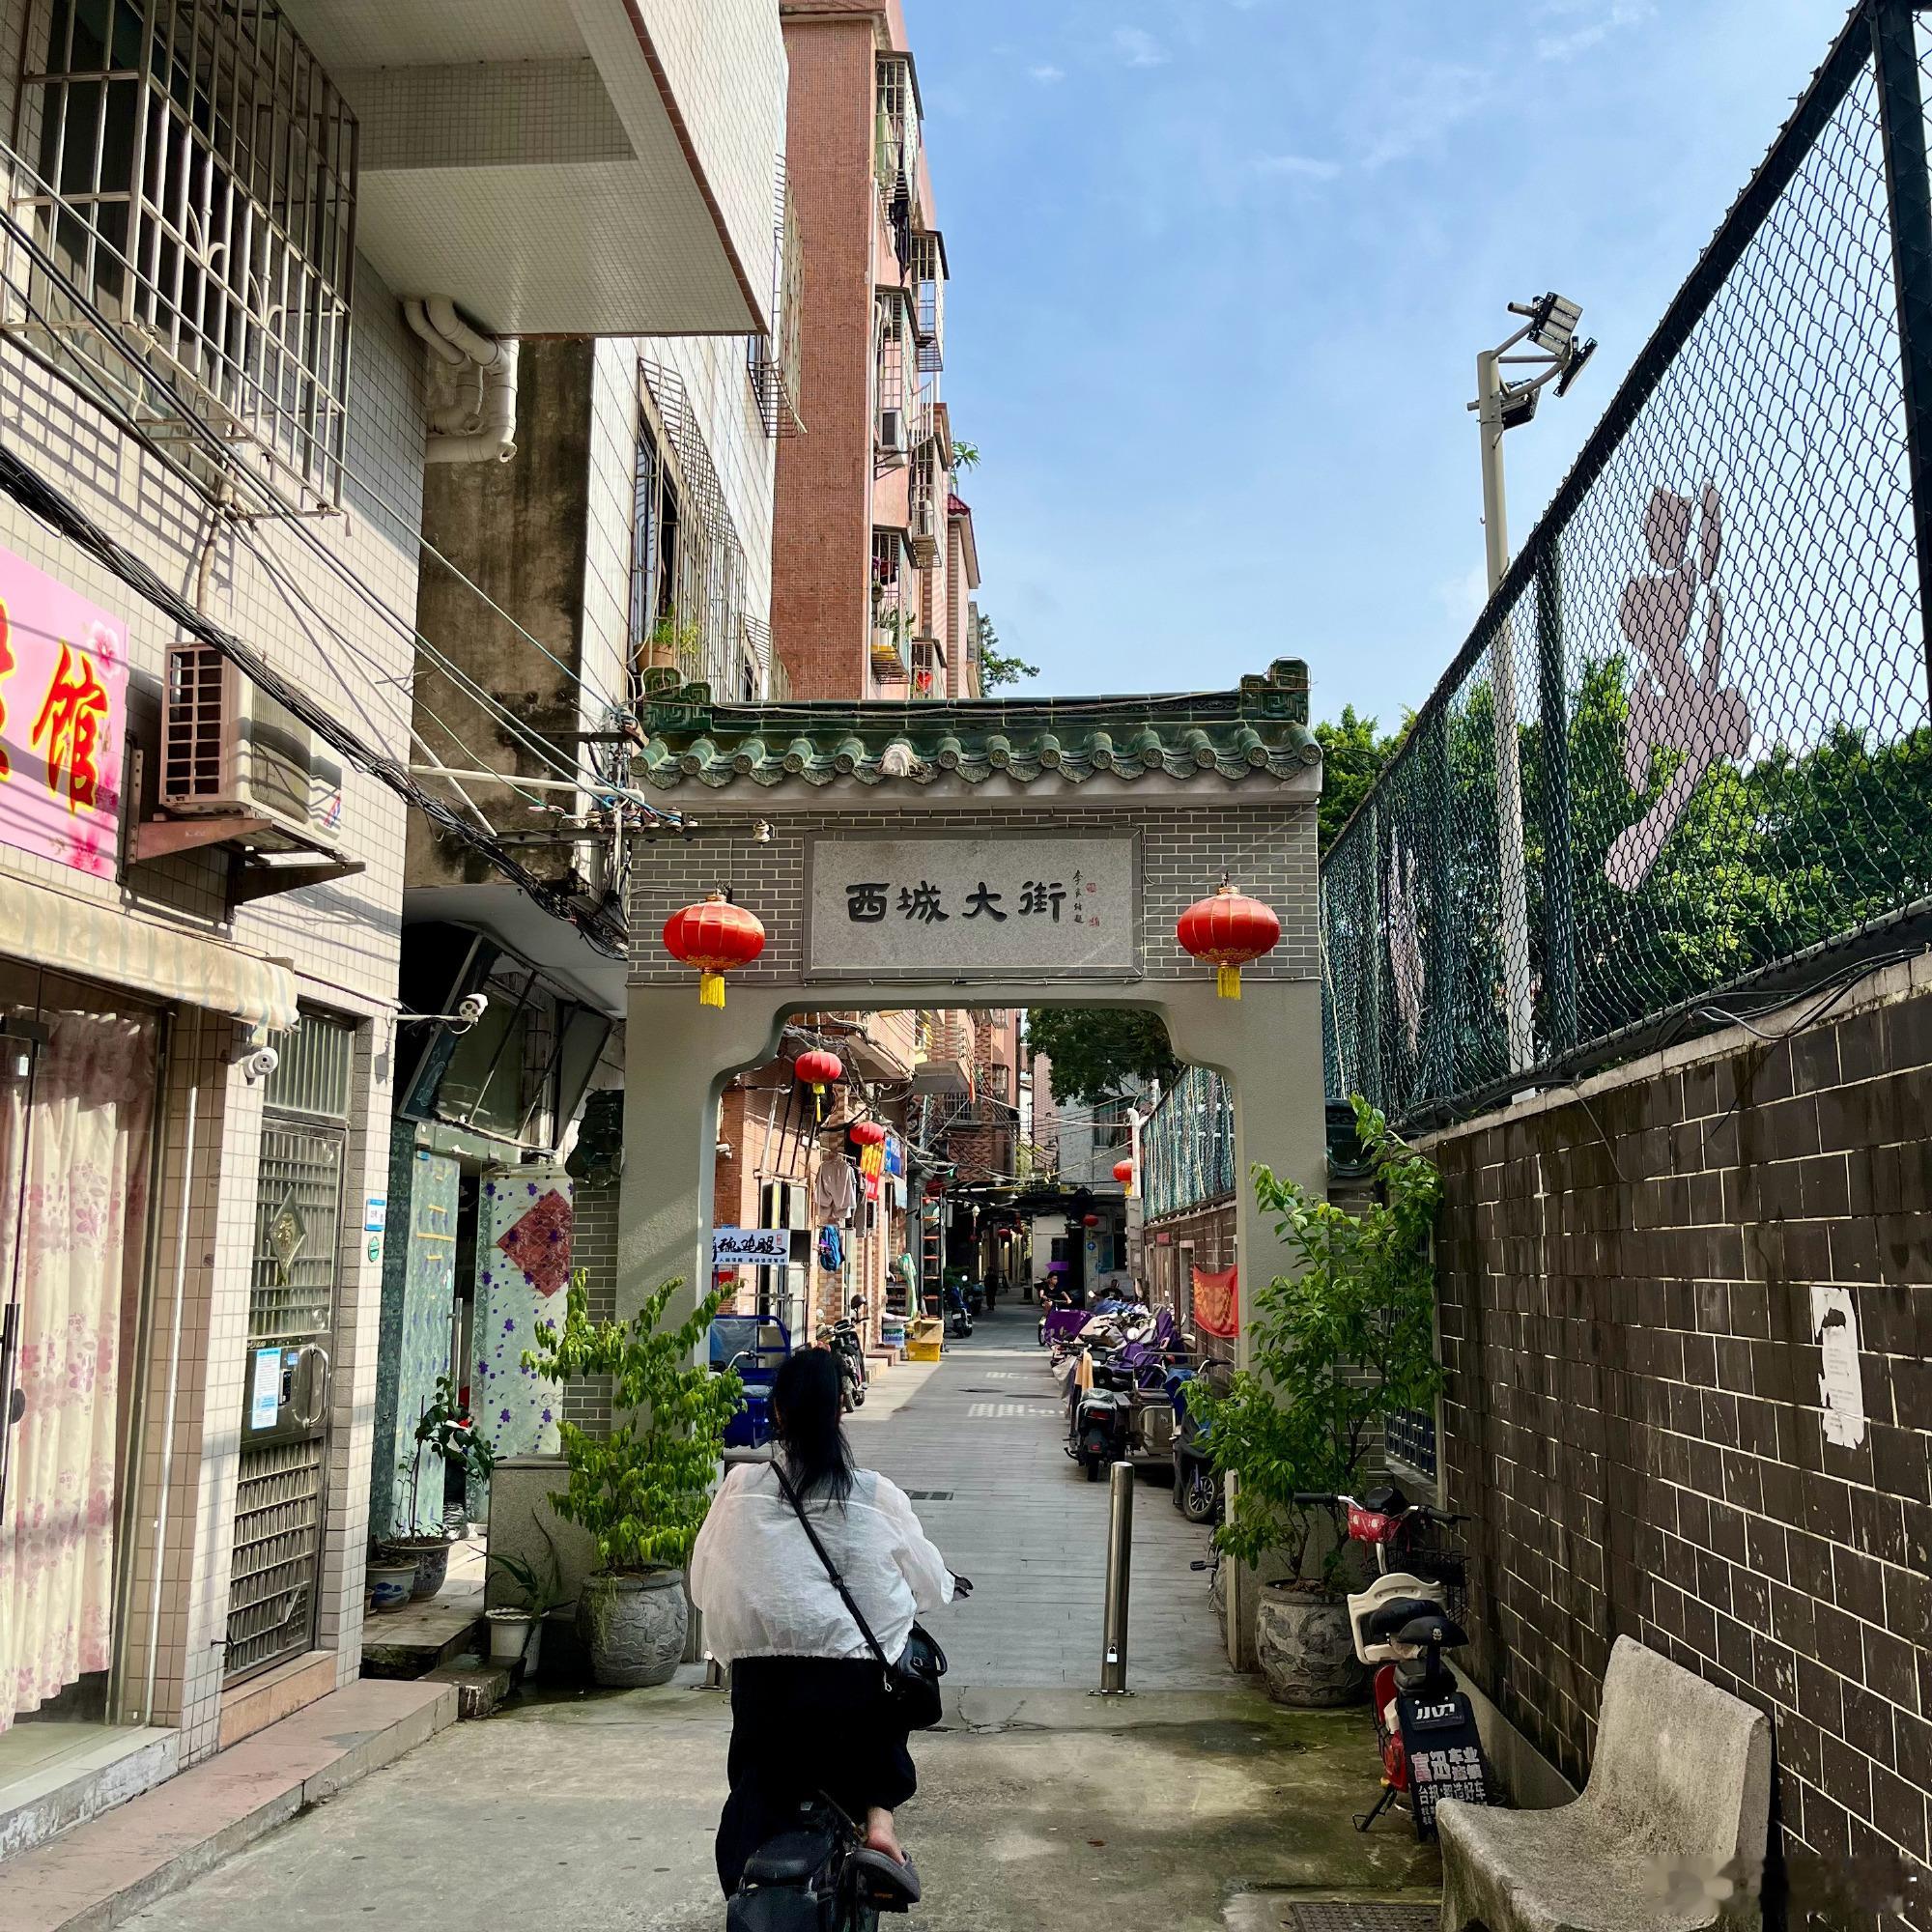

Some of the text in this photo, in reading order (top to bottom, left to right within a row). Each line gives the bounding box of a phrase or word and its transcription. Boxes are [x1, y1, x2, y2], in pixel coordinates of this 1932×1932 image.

[0, 597, 108, 817] 馆
[845, 880, 1067, 924] 西城大街
